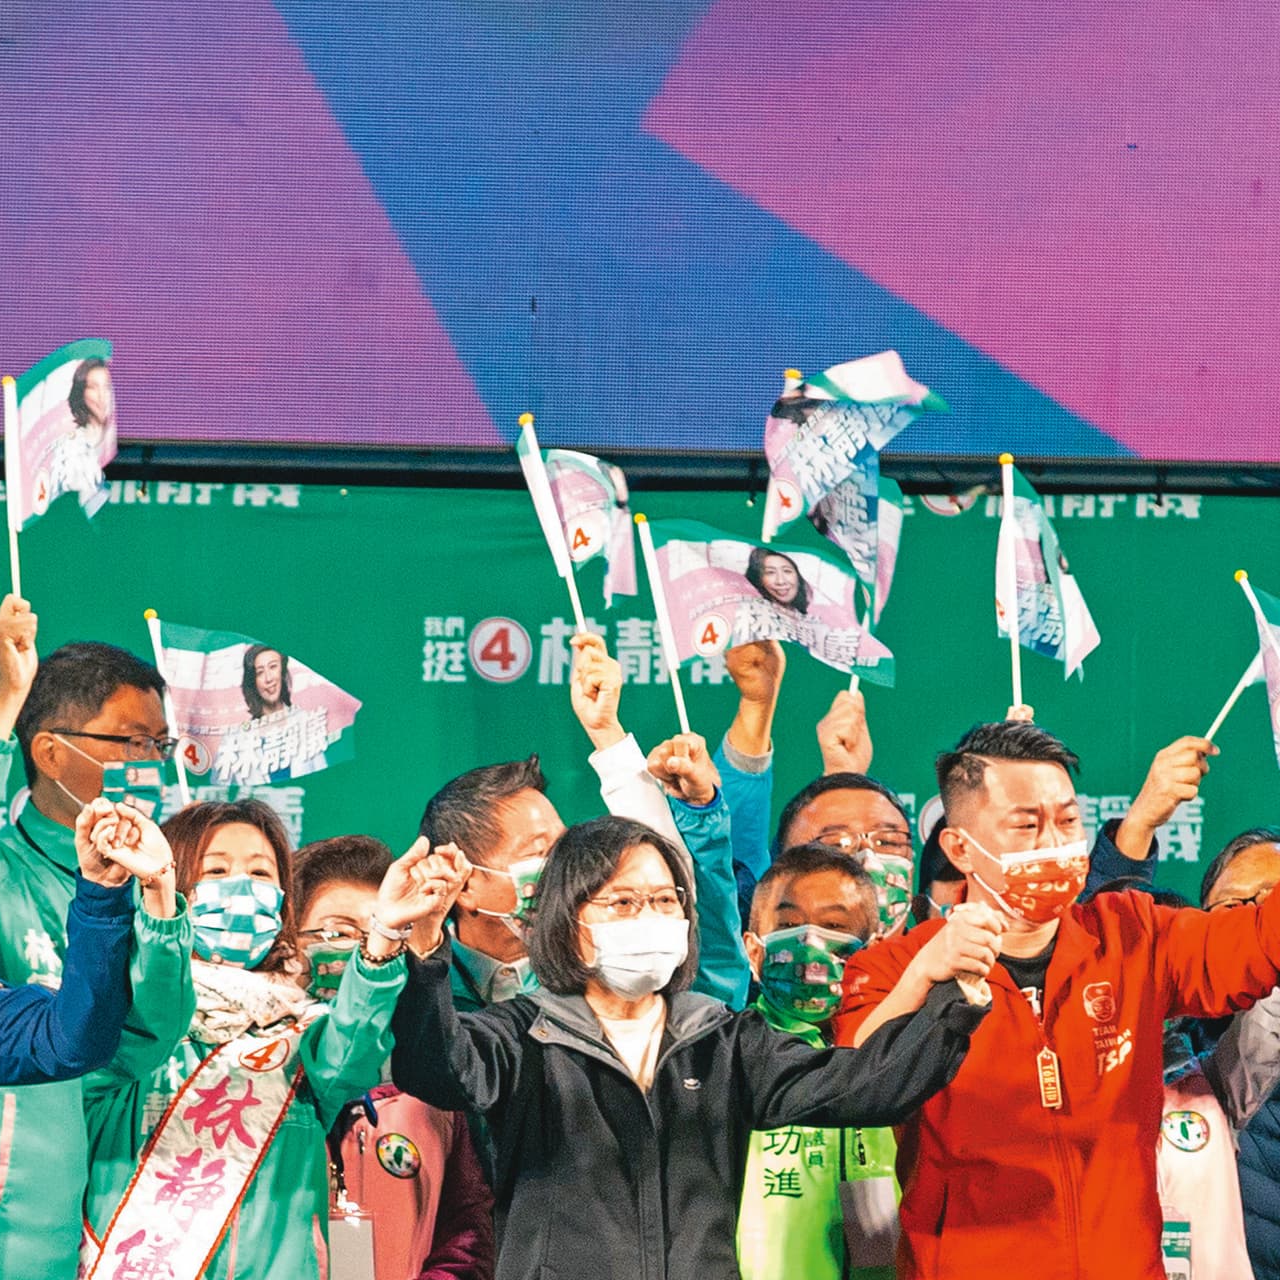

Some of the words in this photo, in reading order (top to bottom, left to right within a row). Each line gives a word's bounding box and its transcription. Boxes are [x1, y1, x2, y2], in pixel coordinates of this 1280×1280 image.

[572, 527, 592, 550] 4
[701, 622, 720, 645] 4
[422, 640, 467, 682] 挺
[479, 627, 517, 671] 4
[183, 743, 201, 766] 4
[762, 1125, 804, 1199] 功進
